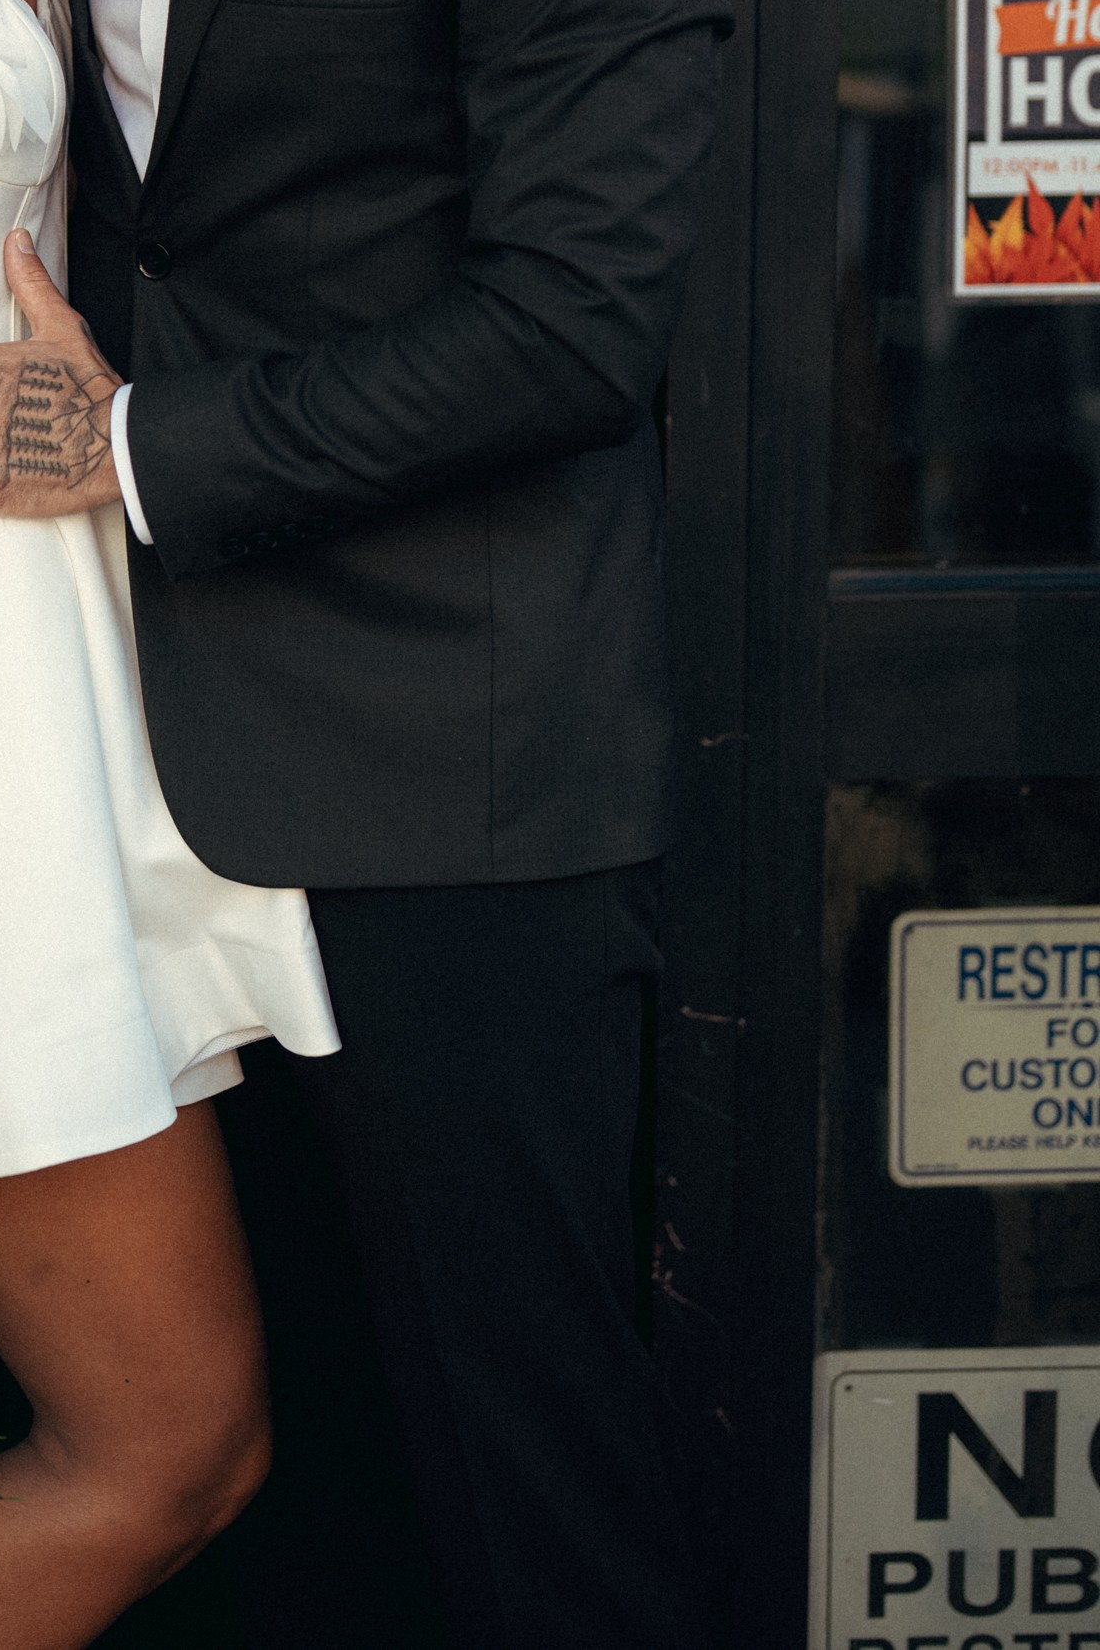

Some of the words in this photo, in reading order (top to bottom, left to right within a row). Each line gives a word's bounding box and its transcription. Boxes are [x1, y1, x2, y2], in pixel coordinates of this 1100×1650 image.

[959, 943, 1100, 1000] RESTR
[961, 1056, 1100, 1091] CUSTO
[1032, 1096, 1100, 1129] ON
[916, 1389, 1100, 1521] N
[867, 1547, 1100, 1620] PUB
